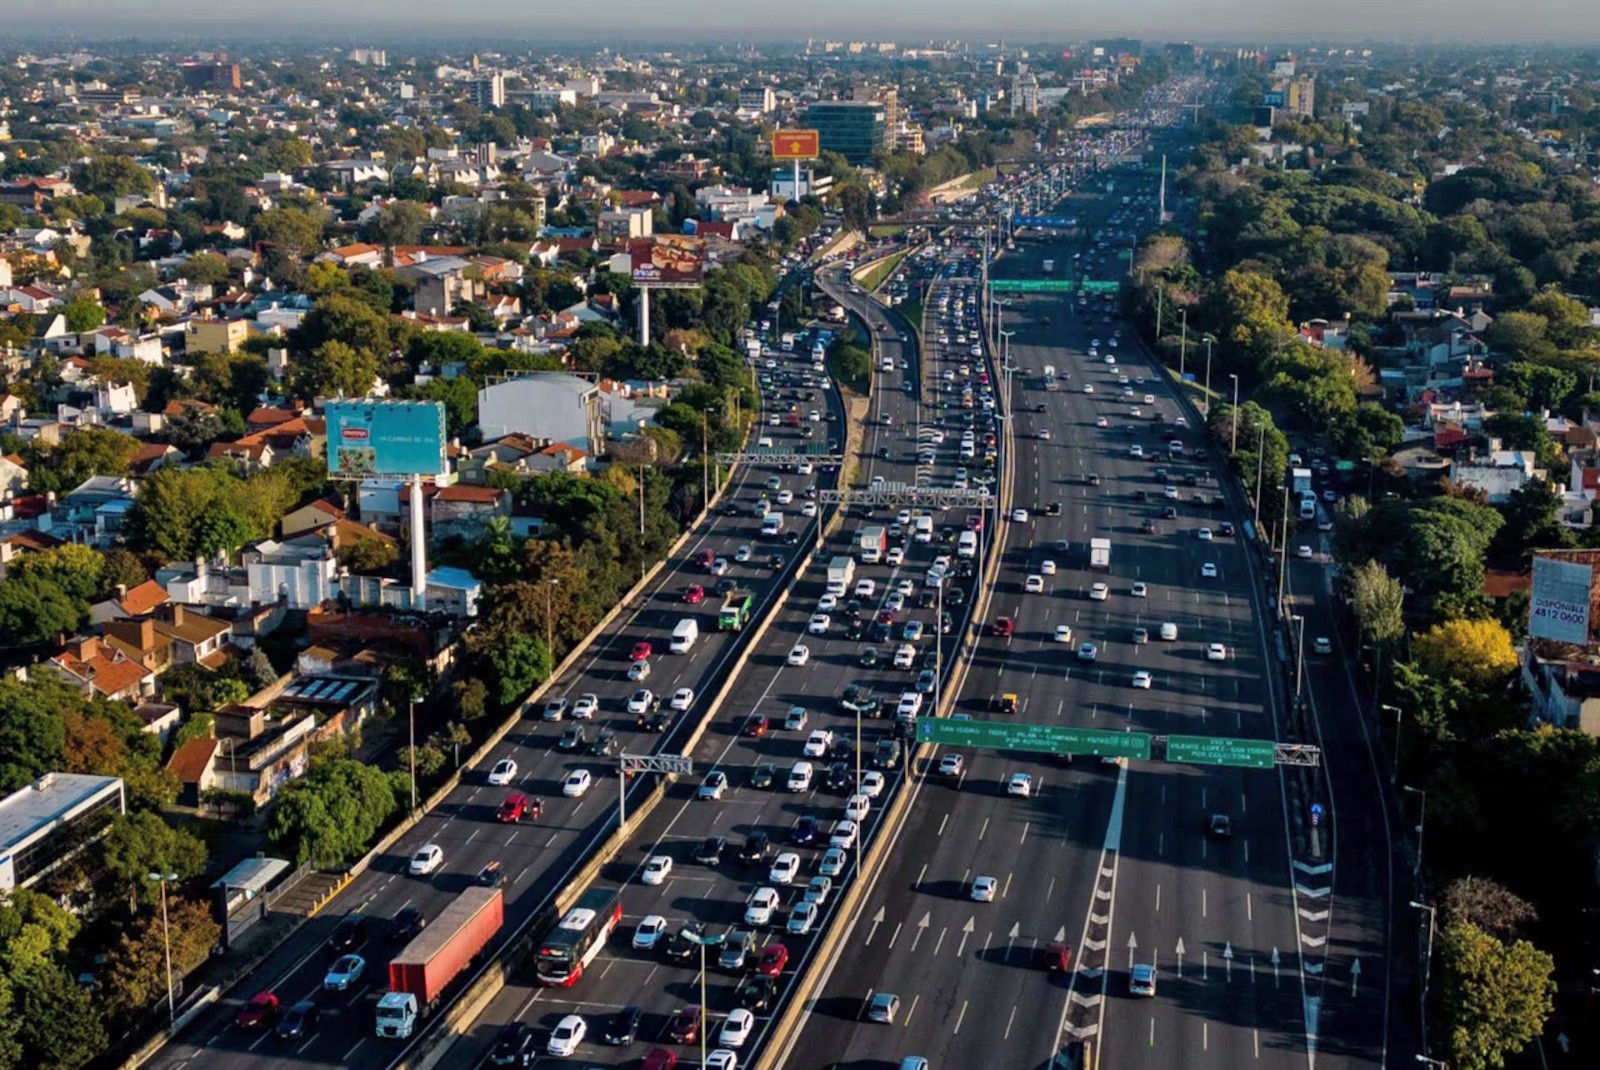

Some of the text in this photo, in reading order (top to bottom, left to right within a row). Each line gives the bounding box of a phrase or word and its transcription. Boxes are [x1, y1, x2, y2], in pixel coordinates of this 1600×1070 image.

[1536, 598, 1584, 614] DISPONIBLE
[1534, 608, 1584, 624] 4812 0600
